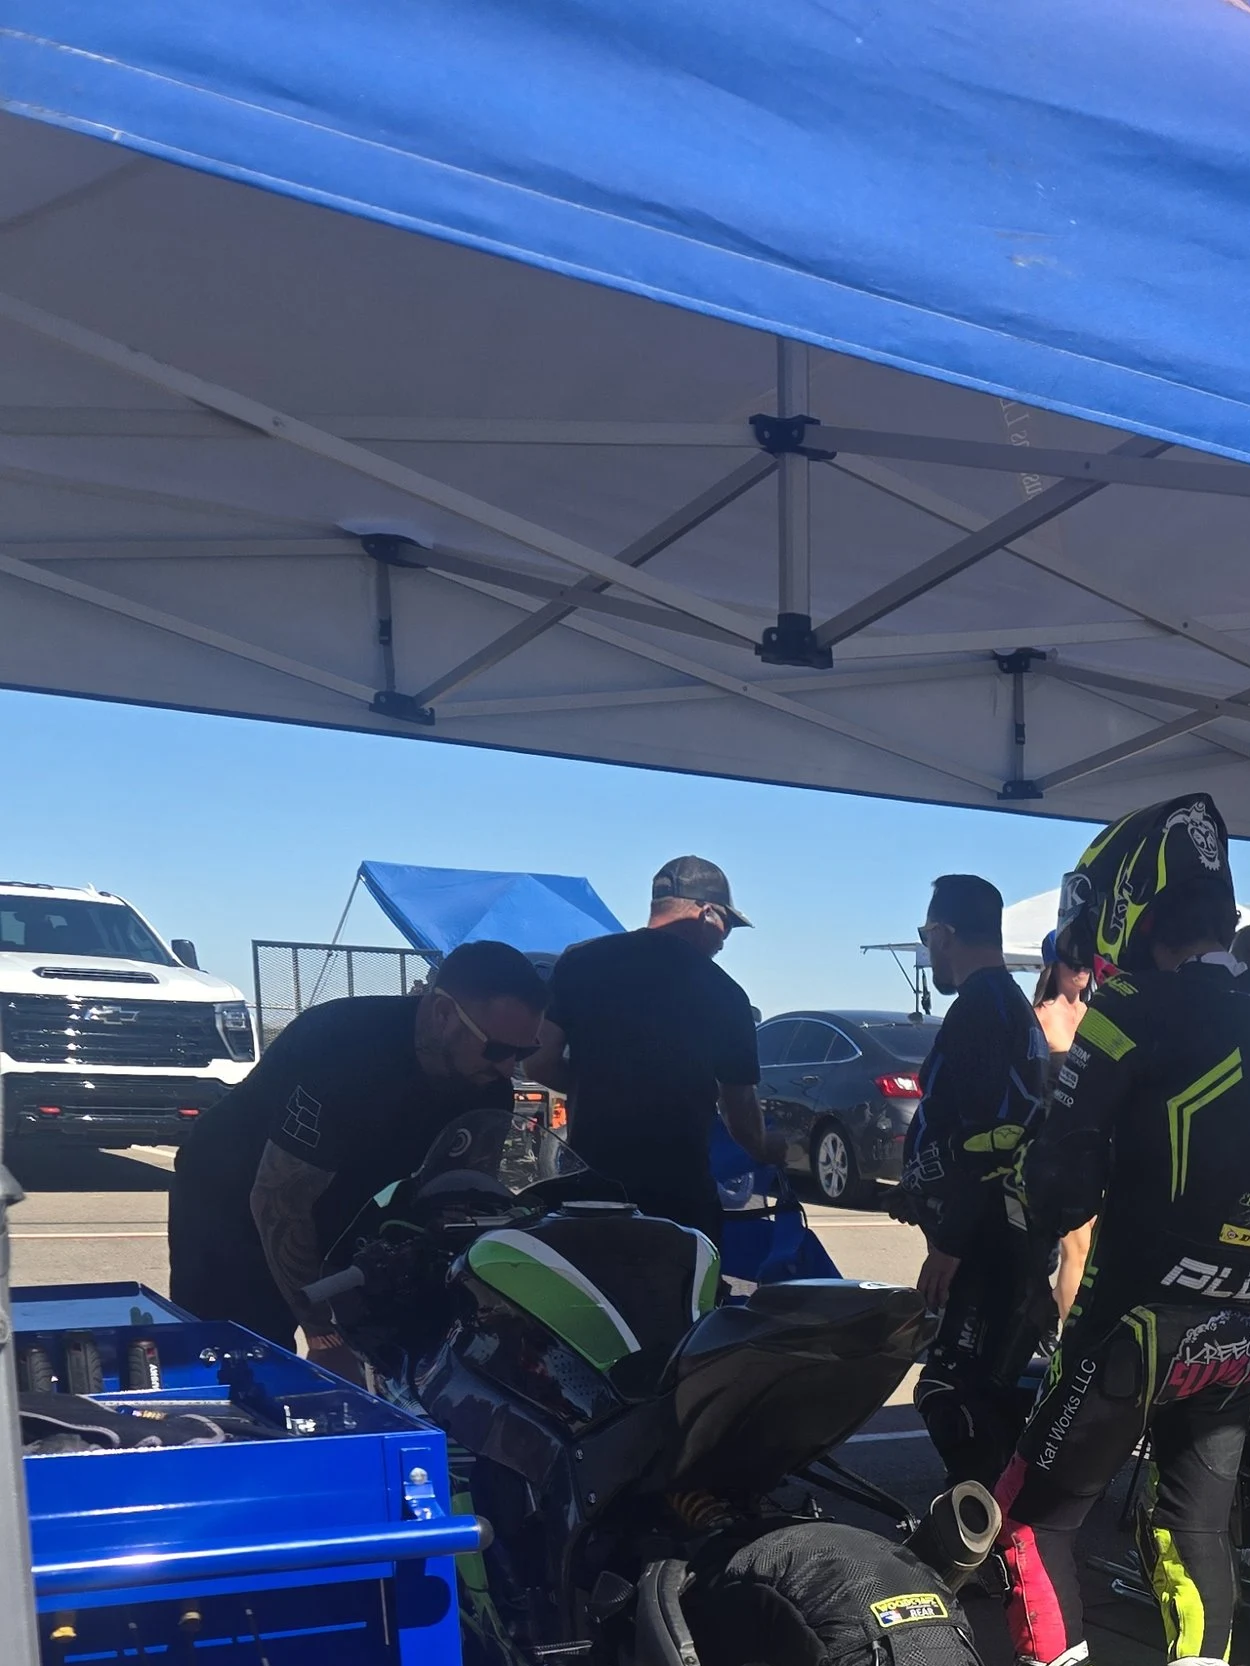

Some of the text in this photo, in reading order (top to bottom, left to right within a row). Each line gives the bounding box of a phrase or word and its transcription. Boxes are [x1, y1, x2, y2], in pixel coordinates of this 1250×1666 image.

[1036, 1358, 1097, 1471] Kat Works LLC
